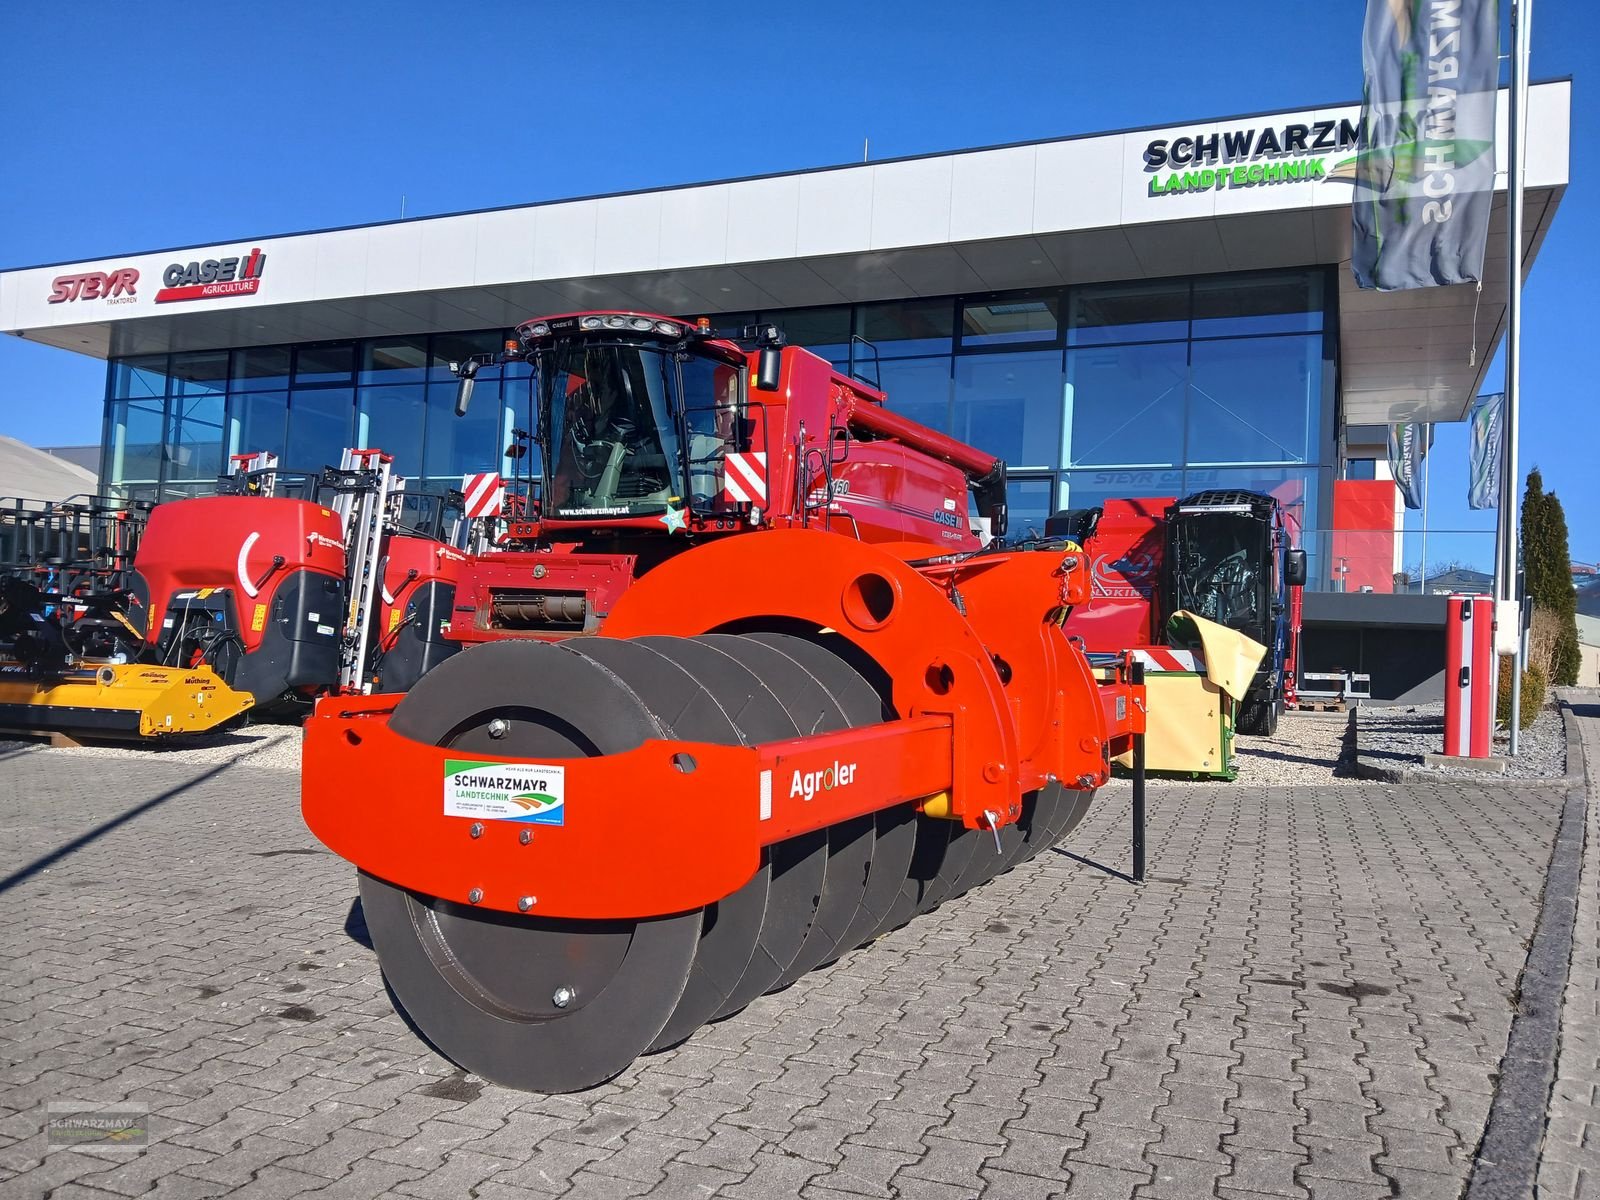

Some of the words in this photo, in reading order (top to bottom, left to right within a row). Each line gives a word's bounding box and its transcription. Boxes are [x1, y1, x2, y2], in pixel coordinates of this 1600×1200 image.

[1146, 119, 1368, 167] SCHWARZM
[1152, 158, 1326, 194] LANDTECHNIK
[163, 257, 239, 287] CASE
[47, 268, 140, 304] STEYR
[201, 281, 254, 295] AGRICULTURE
[106, 297, 137, 305] TRAKTOREN
[1094, 472, 1153, 484] STEYR
[828, 480, 849, 495] 150
[559, 506, 630, 515] www.schwarzmayr.at
[934, 509, 956, 527] CASE
[1094, 588, 1152, 597] LOKING
[185, 676, 210, 684] Müthing
[454, 774, 548, 791] SCHWARZMAYR
[789, 761, 857, 801] Agroler
[456, 790, 510, 801] LANDTECHNIK
